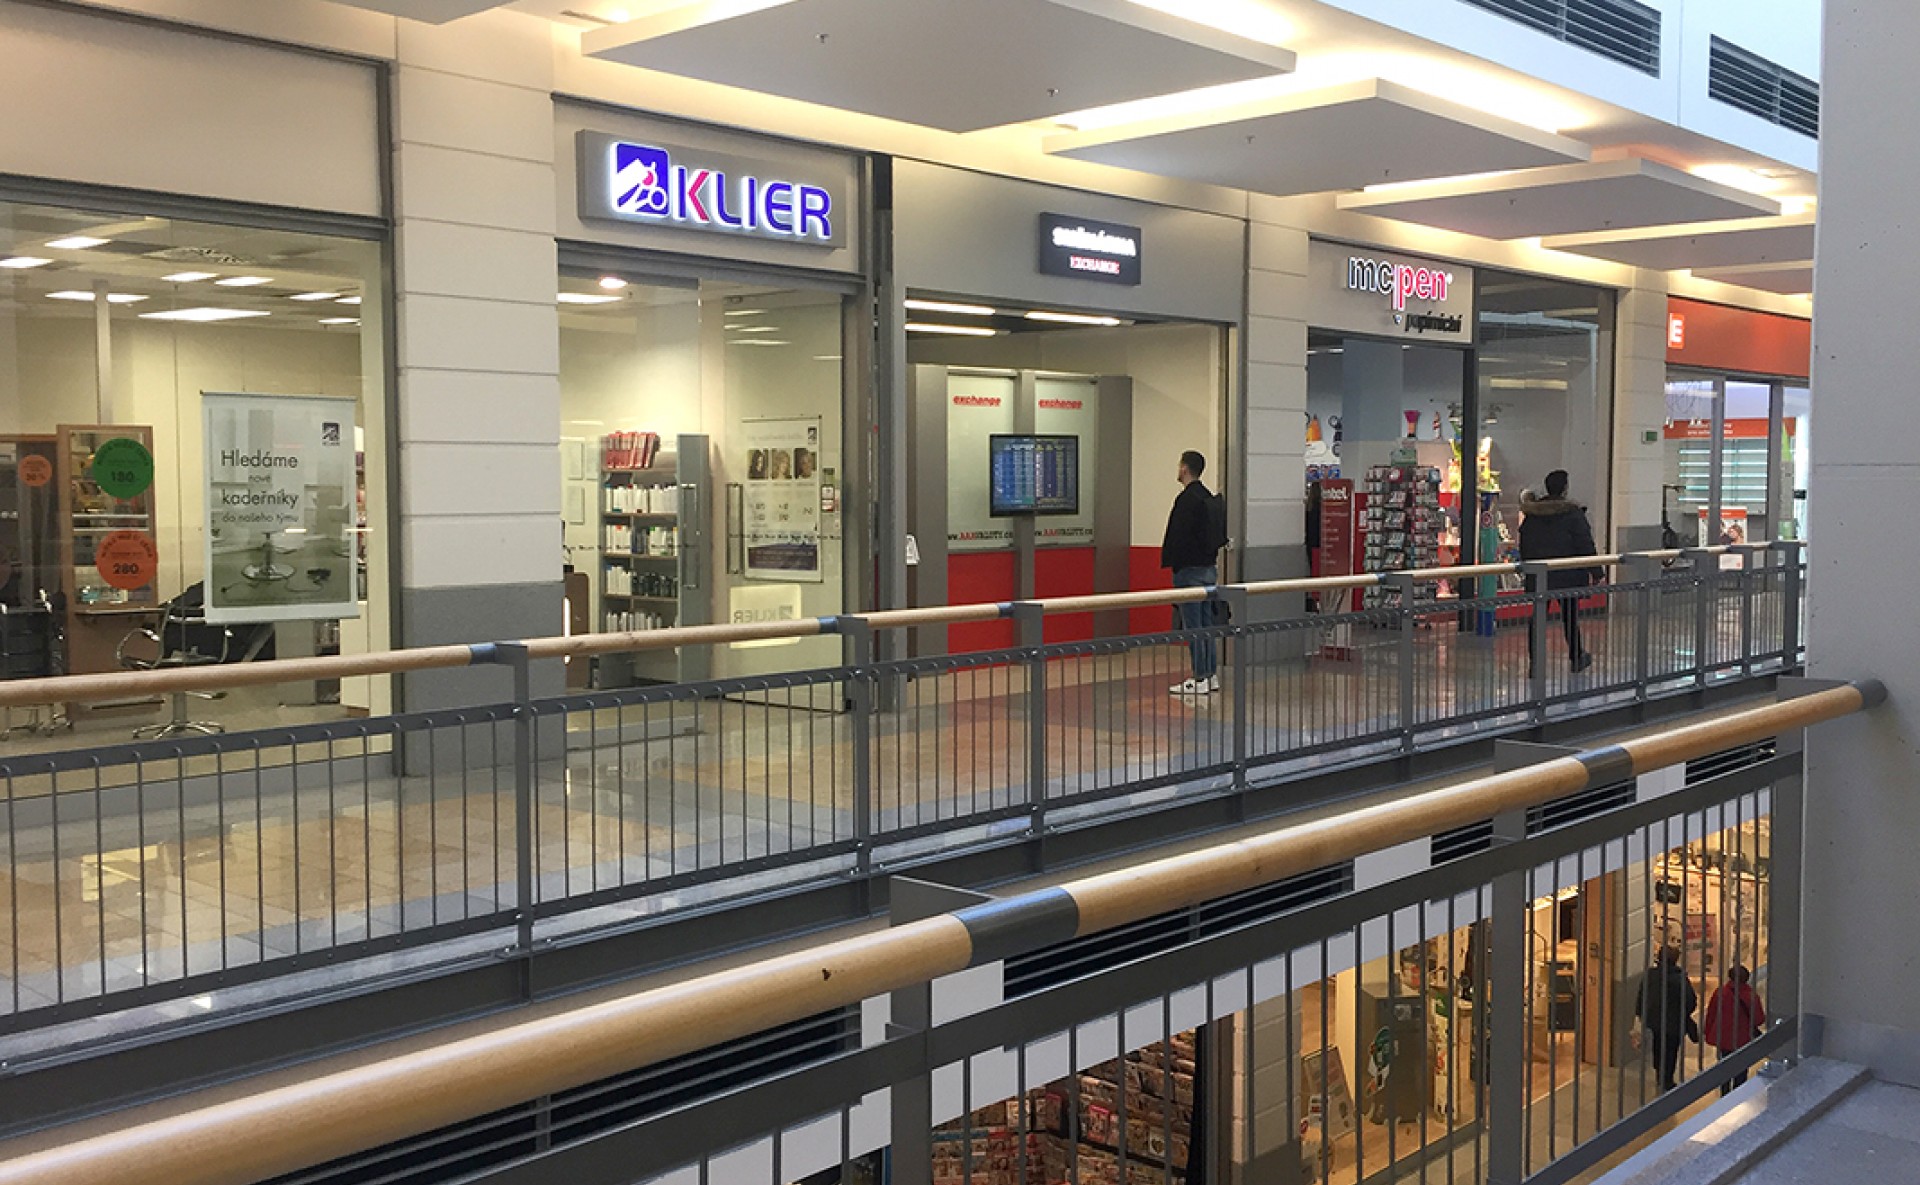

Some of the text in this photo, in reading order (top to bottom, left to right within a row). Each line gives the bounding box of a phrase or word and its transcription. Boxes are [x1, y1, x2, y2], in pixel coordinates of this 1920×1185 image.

[672, 165, 832, 239] KLIER
[1668, 313, 1683, 348] E
[953, 395, 1001, 407] exchange
[220, 449, 298, 468] Hledáme
[222, 488, 299, 510] kadeřníky
